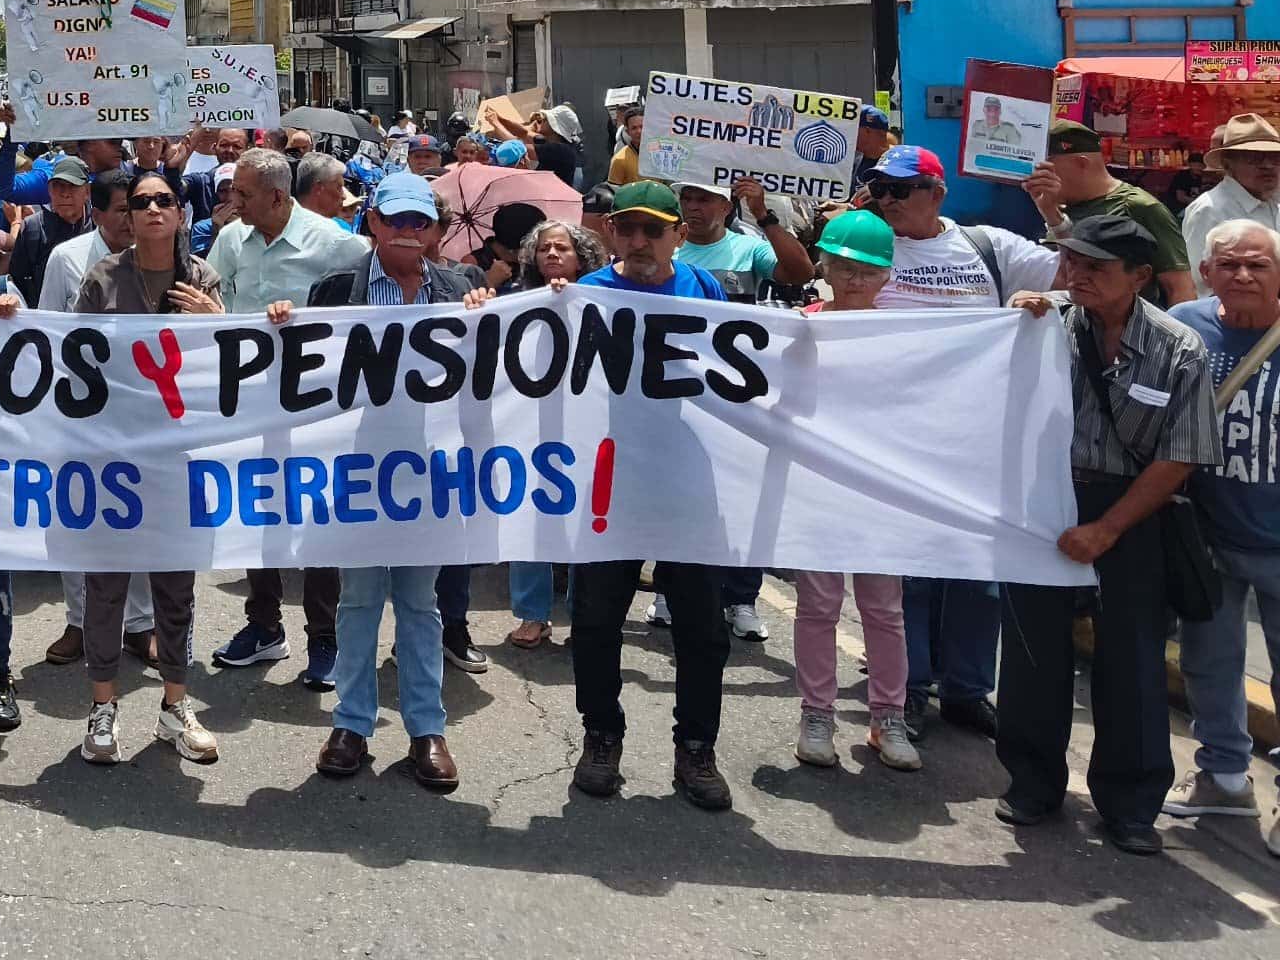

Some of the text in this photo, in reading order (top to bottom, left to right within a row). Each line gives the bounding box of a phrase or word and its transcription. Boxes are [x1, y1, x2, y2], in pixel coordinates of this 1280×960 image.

[1210, 41, 1248, 52] SUPER
[94, 64, 149, 80] Art. 91
[47, 93, 90, 106] U.S.B
[792, 93, 859, 121] U.S.B
[97, 108, 150, 122] SUTES
[671, 115, 782, 149] SIEMPRE
[131, 327, 185, 420] Y
[213, 303, 770, 417] PENSIONES
[188, 437, 616, 534] DERECHOS!
